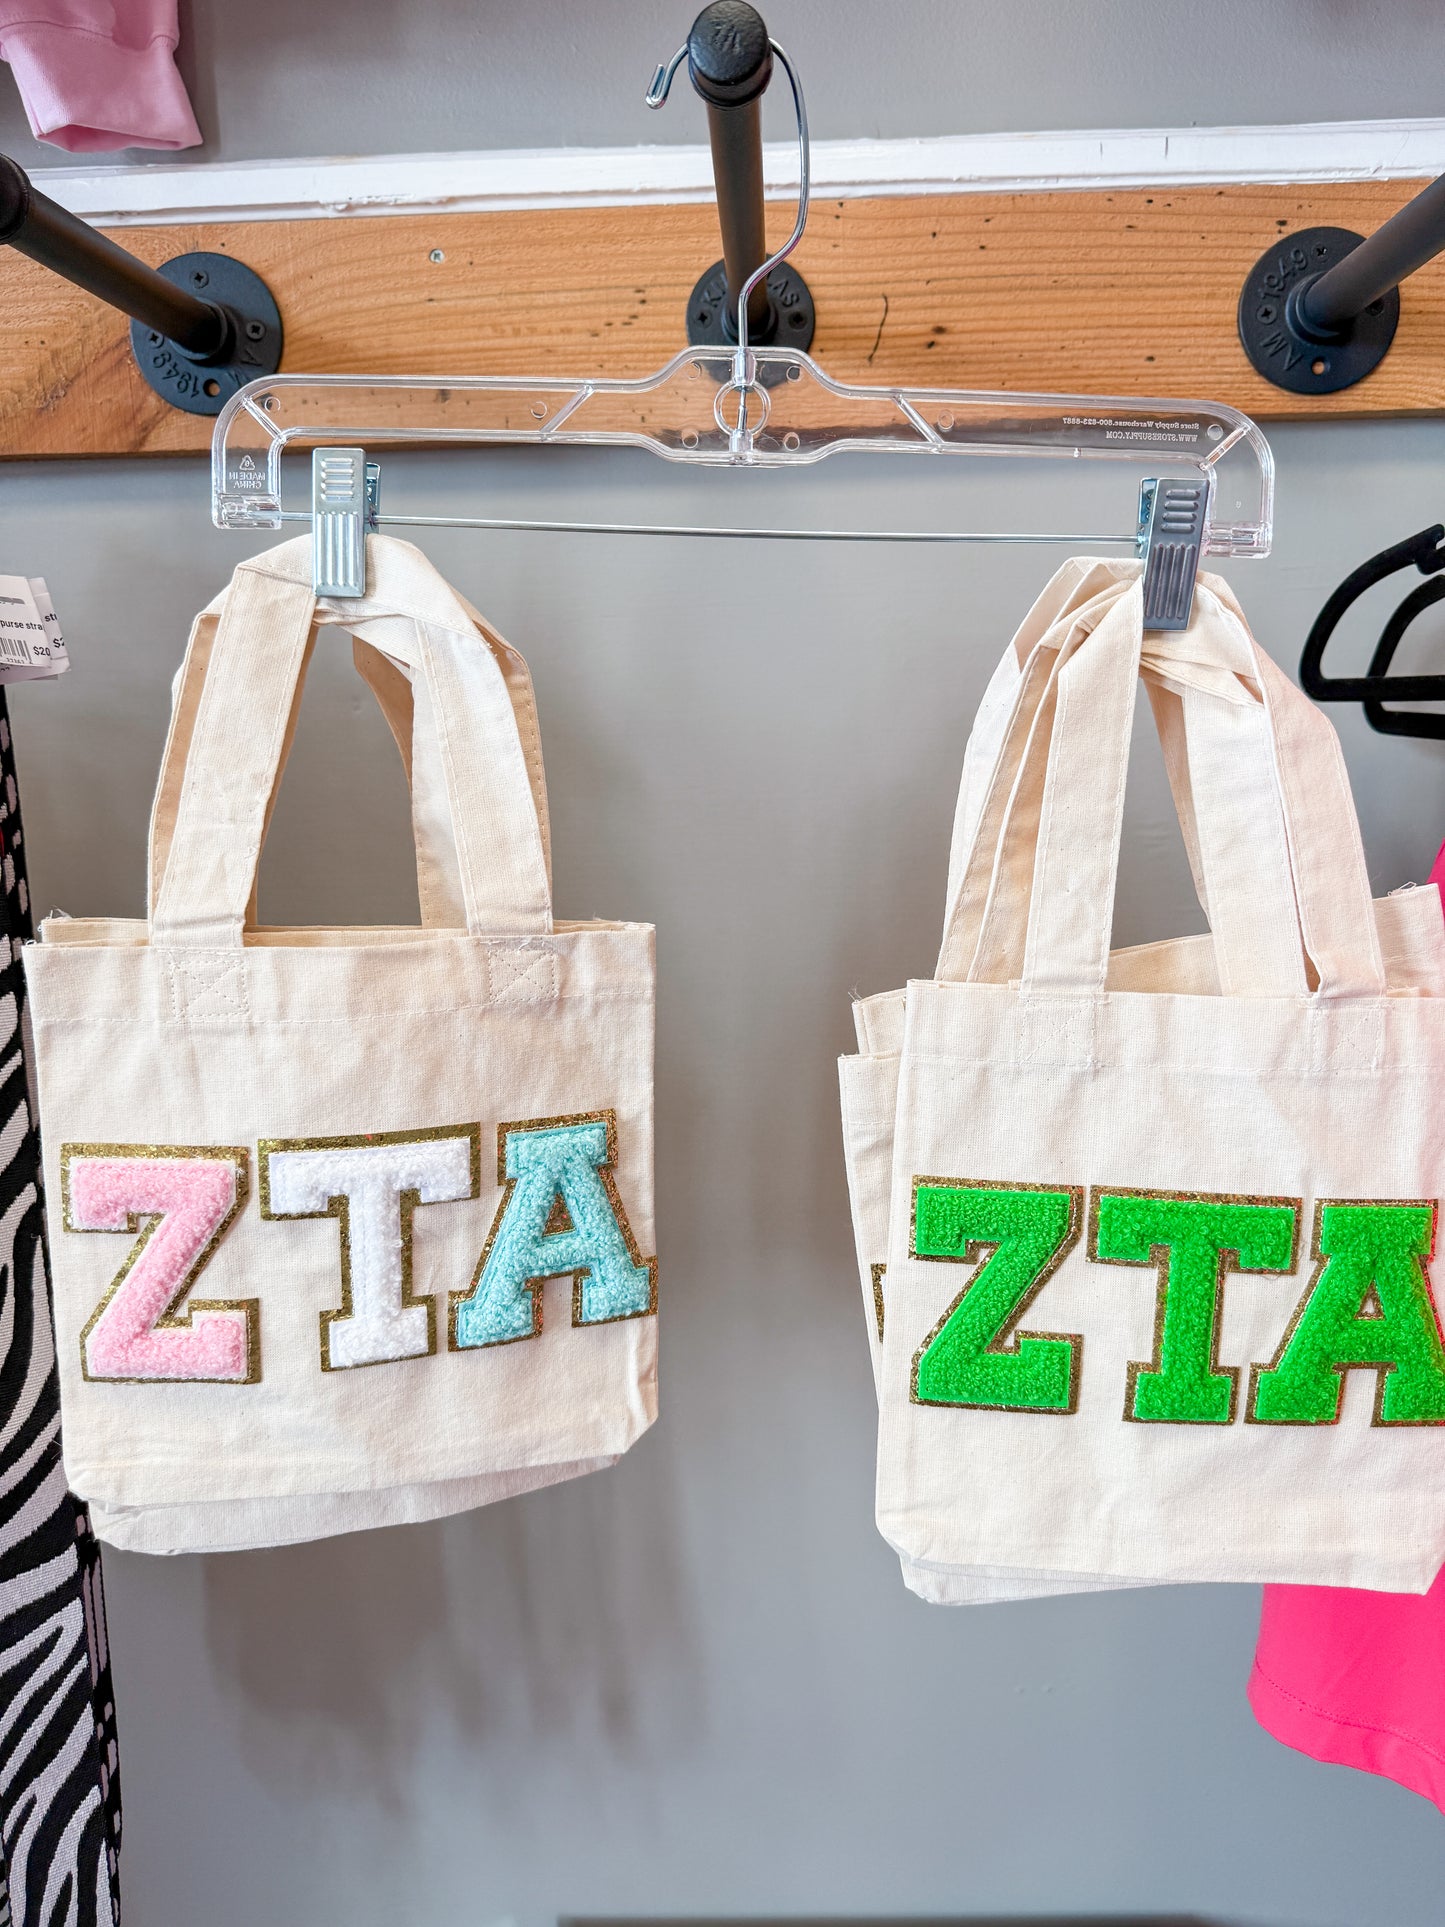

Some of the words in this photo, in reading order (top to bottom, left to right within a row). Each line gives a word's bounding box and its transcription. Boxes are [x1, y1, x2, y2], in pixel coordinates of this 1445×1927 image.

[1259, 247, 1308, 299] 1949
[0, 620, 24, 629] purse
[33, 645, 51, 657] $20
[60, 1108, 659, 1384] ZTA
[908, 1175, 1445, 1427] ZTA
